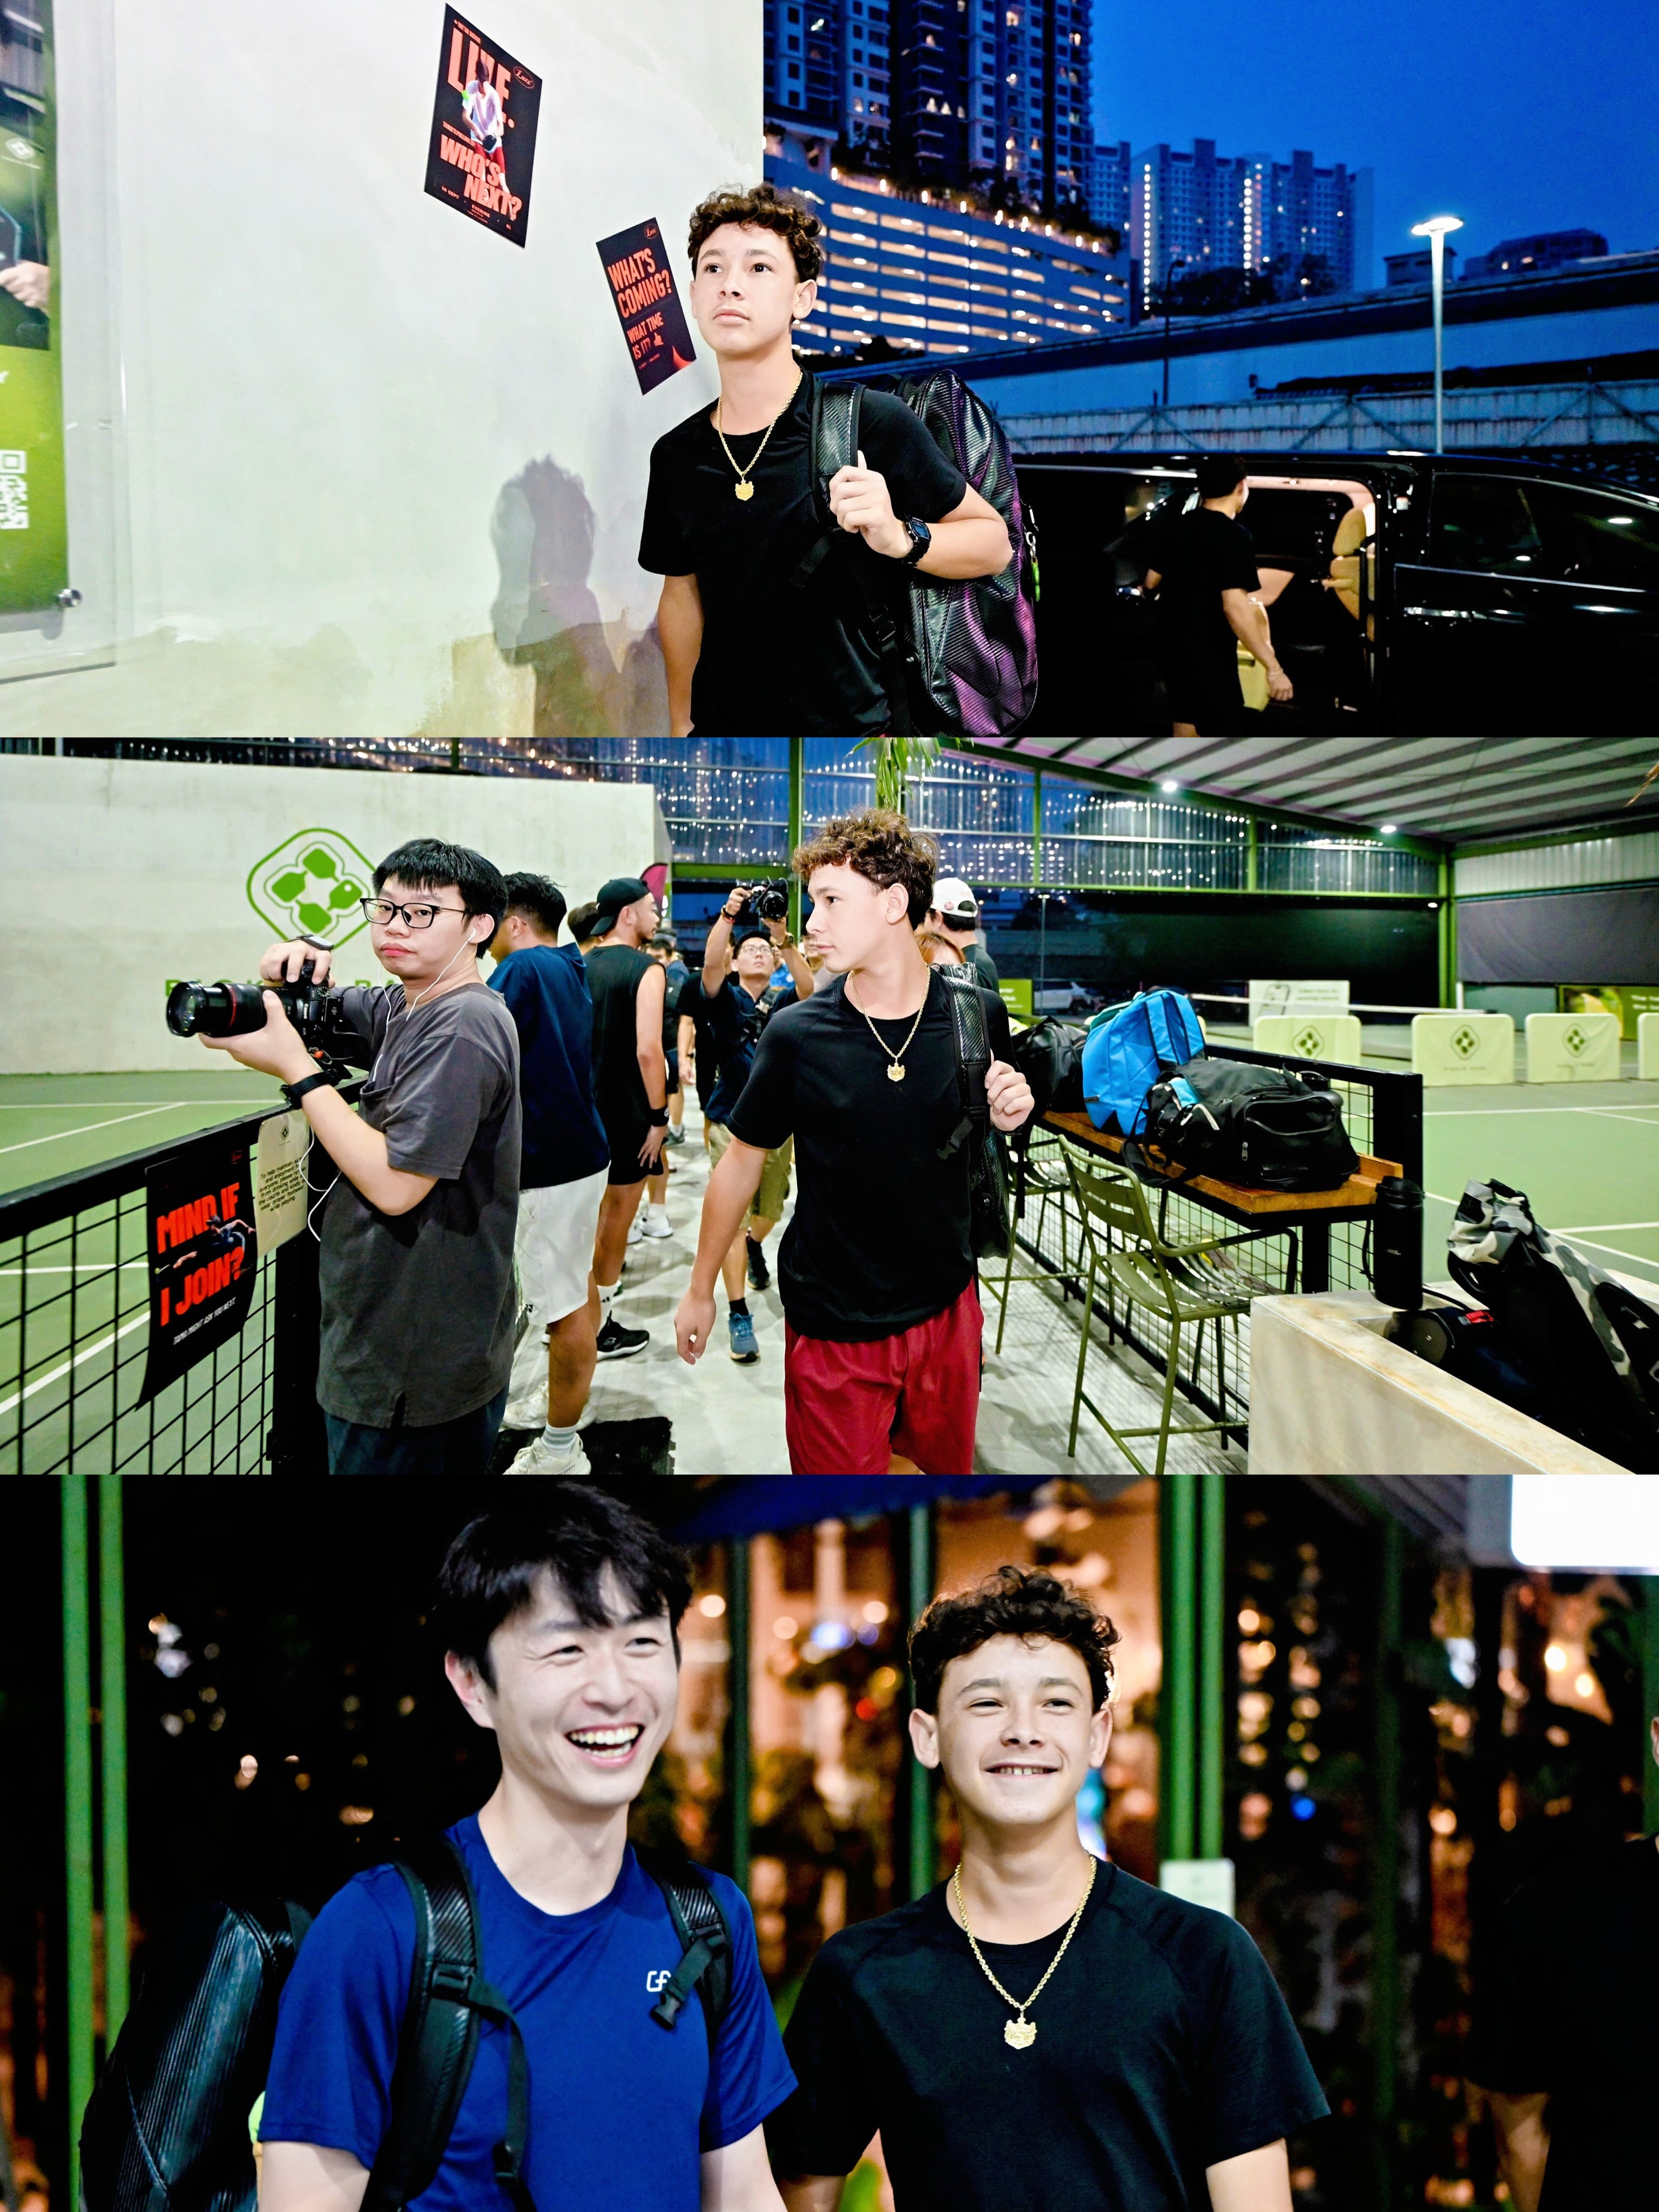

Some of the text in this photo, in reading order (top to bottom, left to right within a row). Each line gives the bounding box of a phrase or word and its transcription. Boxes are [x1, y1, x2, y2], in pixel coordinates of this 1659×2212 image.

[440, 134, 501, 186] WHO'S
[464, 173, 522, 220] NEXT?
[608, 248, 656, 291] WHAT'S
[617, 269, 672, 318] COMING?
[627, 312, 664, 343] WHAT TIME
[632, 342, 642, 360] IS
[274, 1166, 294, 1179] enjoyment
[276, 1161, 293, 1172] maintain
[280, 1173, 292, 1185] please
[273, 1181, 288, 1192] drinking
[273, 1194, 286, 1205] proper
[287, 1185, 304, 1197] footwear
[290, 1181, 300, 1189] kindly
[156, 1182, 239, 1253] MIND IF
[161, 1246, 245, 1327] I JOIN?
